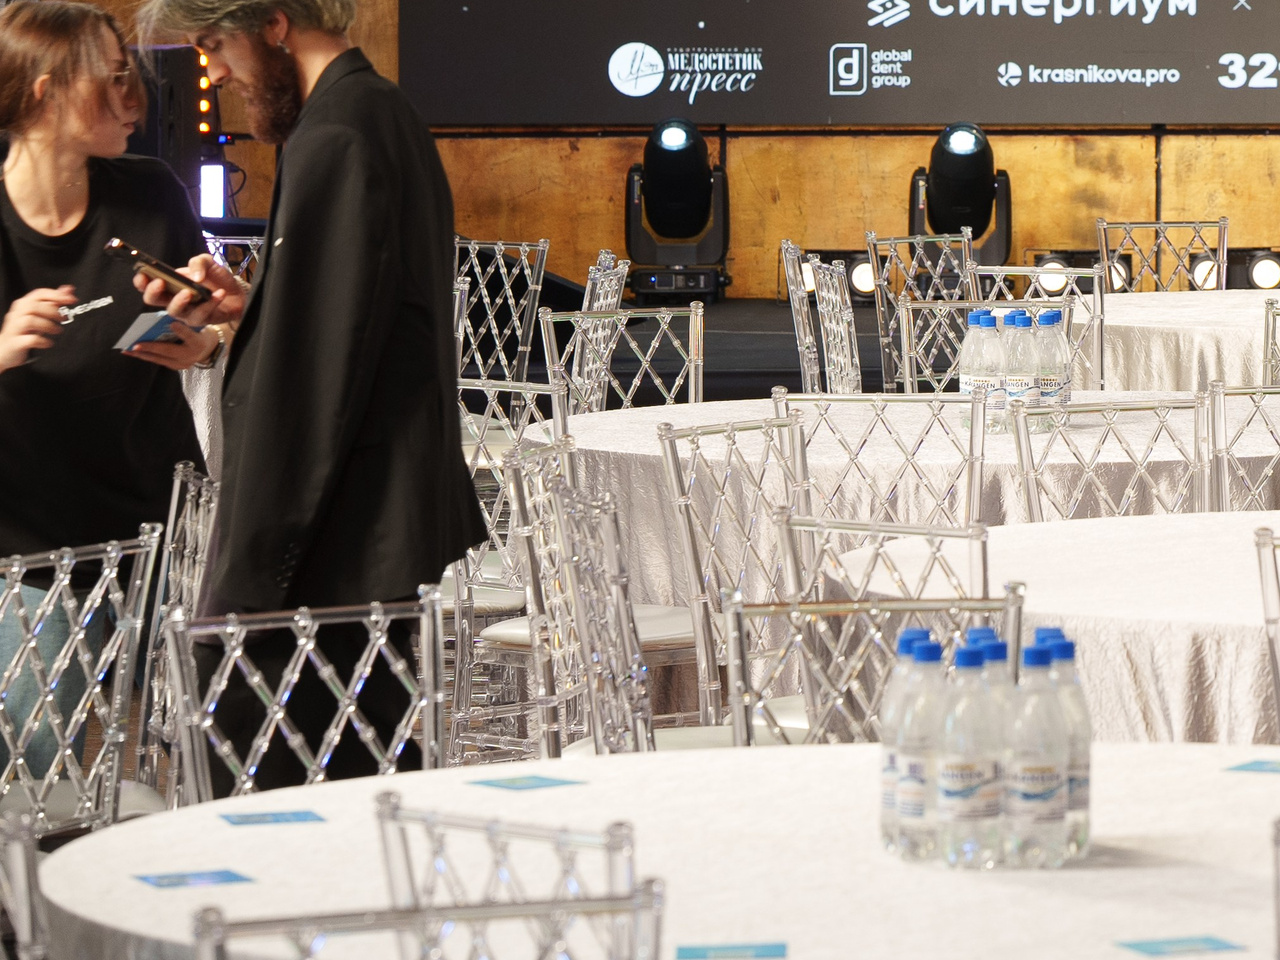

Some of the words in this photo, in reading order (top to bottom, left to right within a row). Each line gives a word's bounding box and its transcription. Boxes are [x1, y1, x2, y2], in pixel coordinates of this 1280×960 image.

[871, 49, 912, 64] global
[871, 62, 902, 74] dent
[1028, 64, 1181, 87] krasnikova.pro
[669, 71, 757, 105] пресс
[871, 75, 911, 88] group
